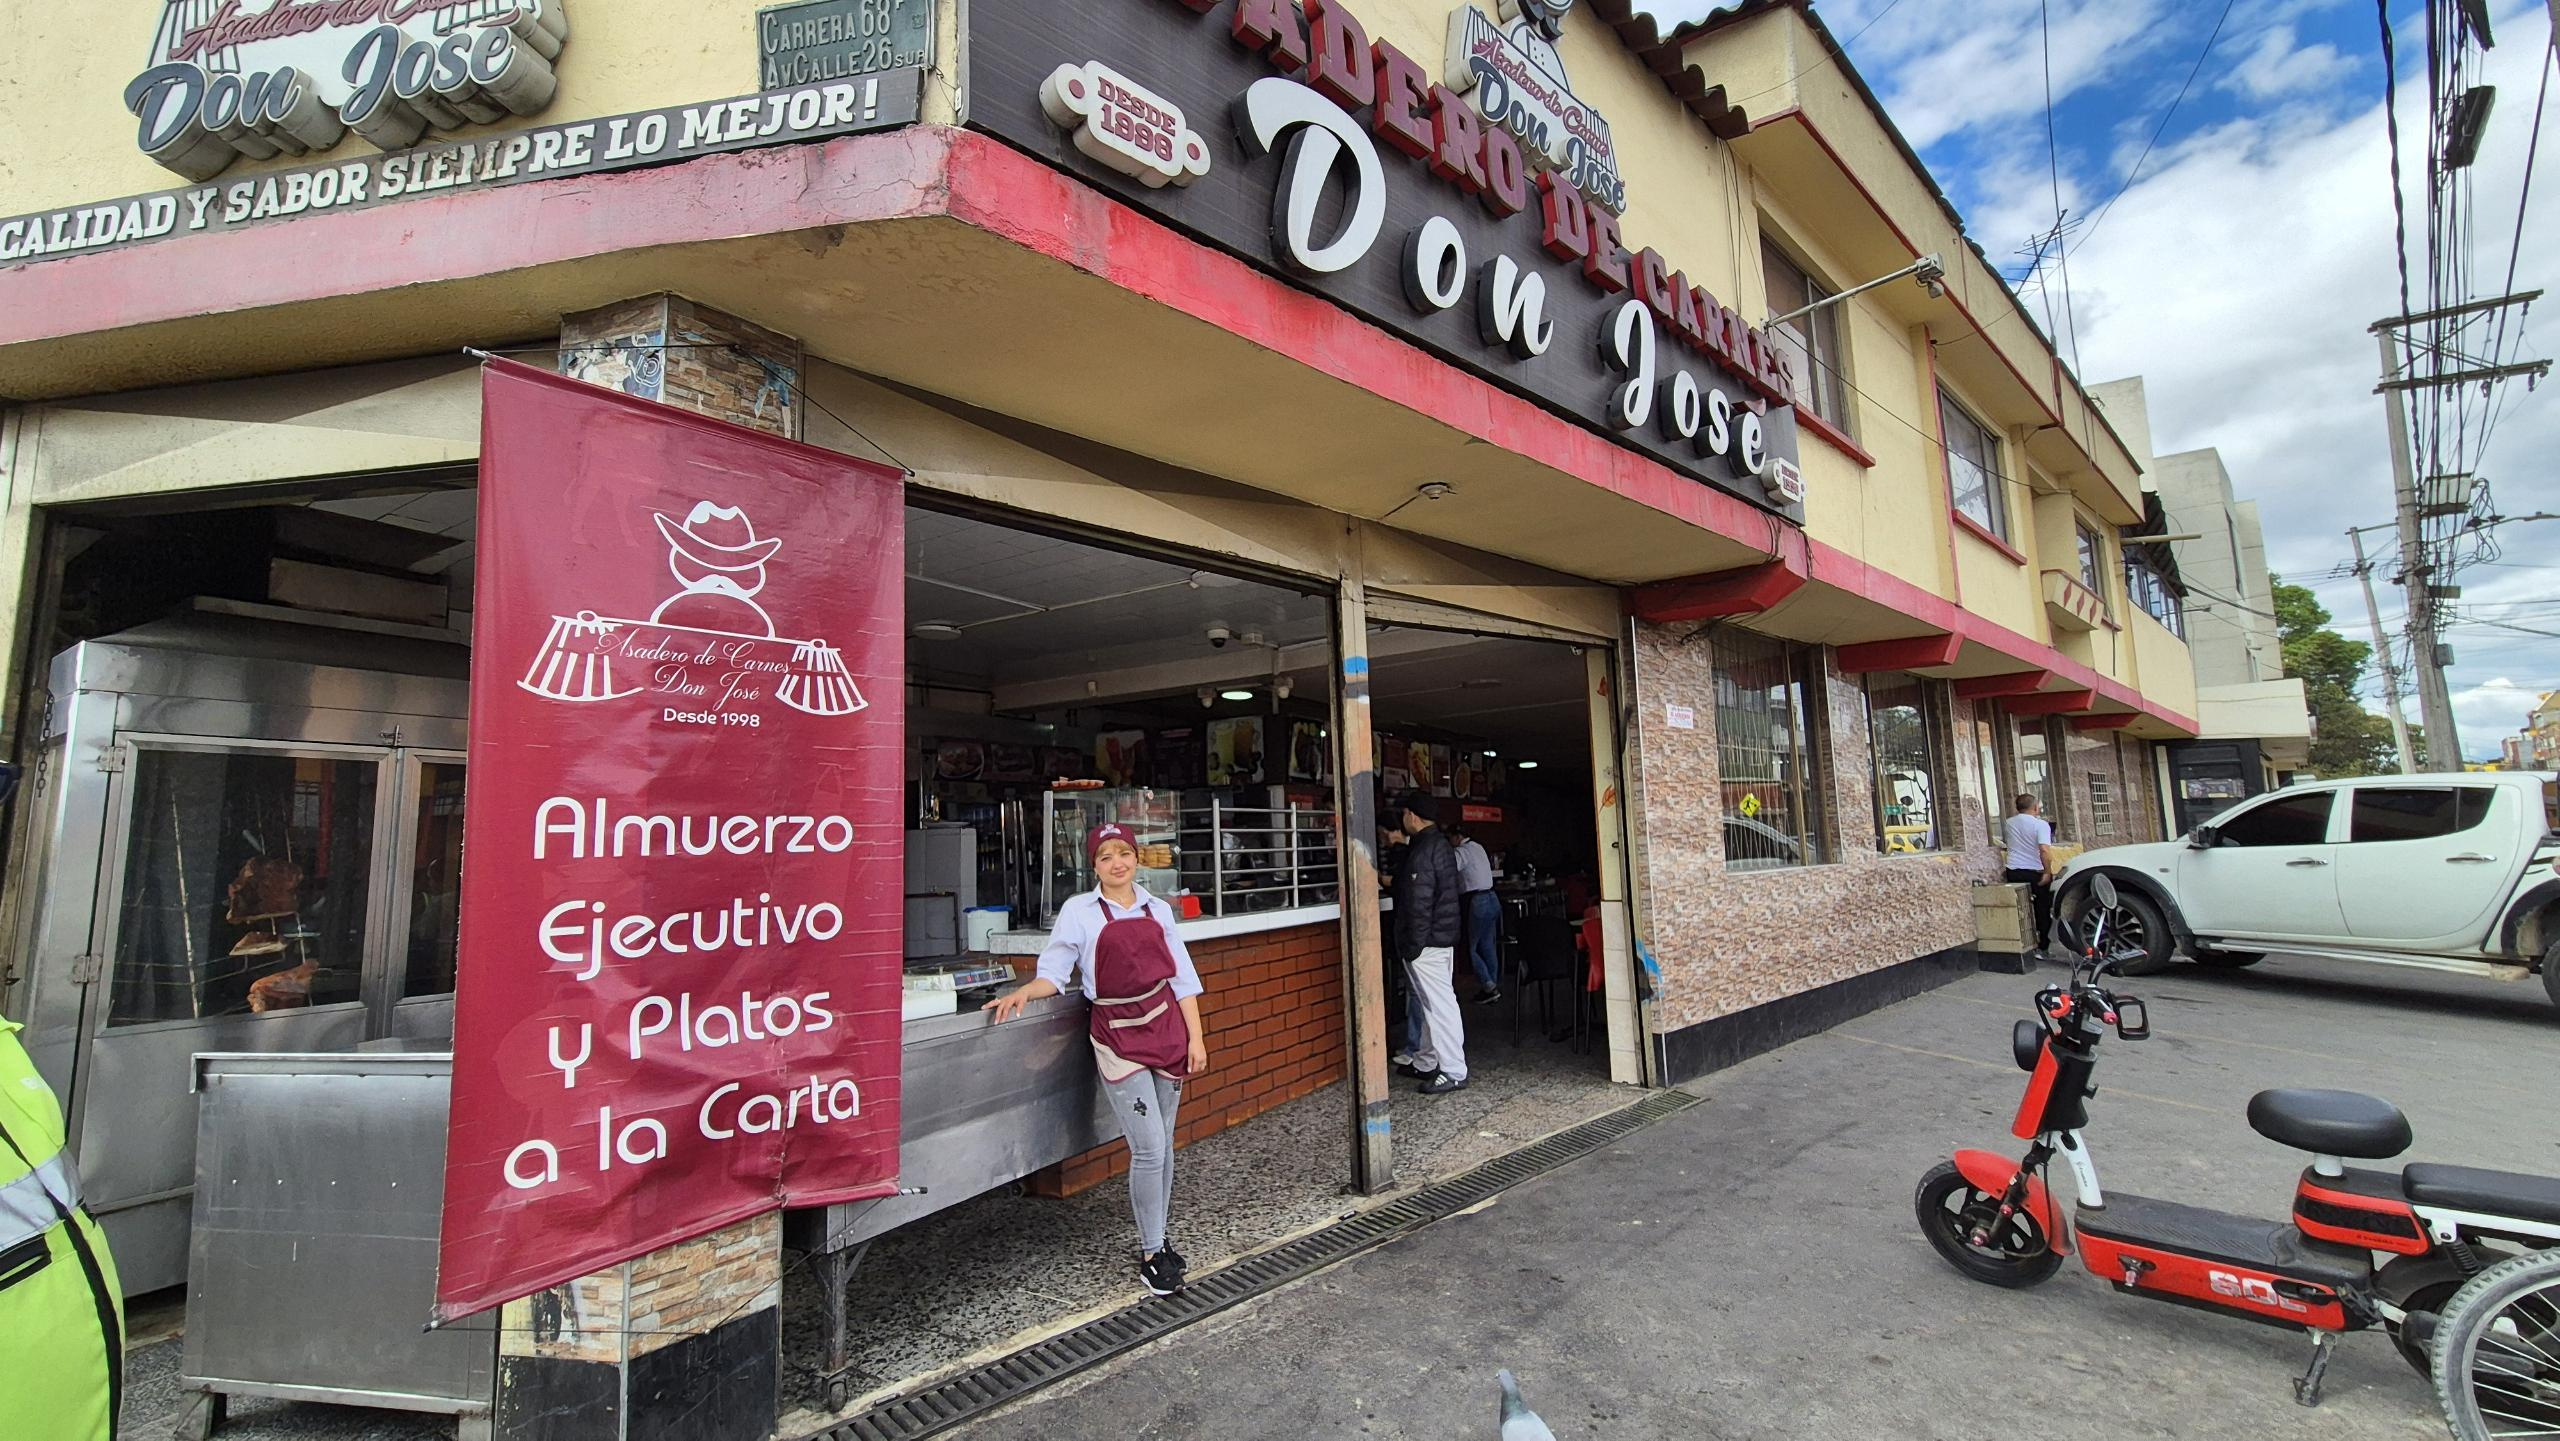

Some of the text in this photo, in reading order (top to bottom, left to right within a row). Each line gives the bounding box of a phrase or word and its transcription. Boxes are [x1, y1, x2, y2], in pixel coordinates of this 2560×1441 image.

[124, 8, 520, 155] Don José
[862, 37, 893, 73] 26
[1472, 37, 1544, 101] Asadero
[1543, 89, 1563, 117] de
[1097, 76, 1177, 137] DESDE
[1100, 103, 1174, 162] 1998
[1469, 54, 1627, 215] Don José
[0, 78, 879, 261] CALIDAD Y SABOR SIEMPRE LO MEJOR!
[1246, 77, 1768, 475] Don José
[1543, 168, 1628, 290] DE
[1636, 246, 1797, 406] CARNES
[594, 628, 792, 673] Asadero de Carnes
[650, 663, 761, 712] Don José
[663, 708, 761, 727] Desde 1998
[533, 796, 853, 860] Almuerzo
[538, 892, 843, 981] Ejecutivo
[548, 991, 833, 1089] y Platos
[503, 1074, 861, 1189] a la Carta
